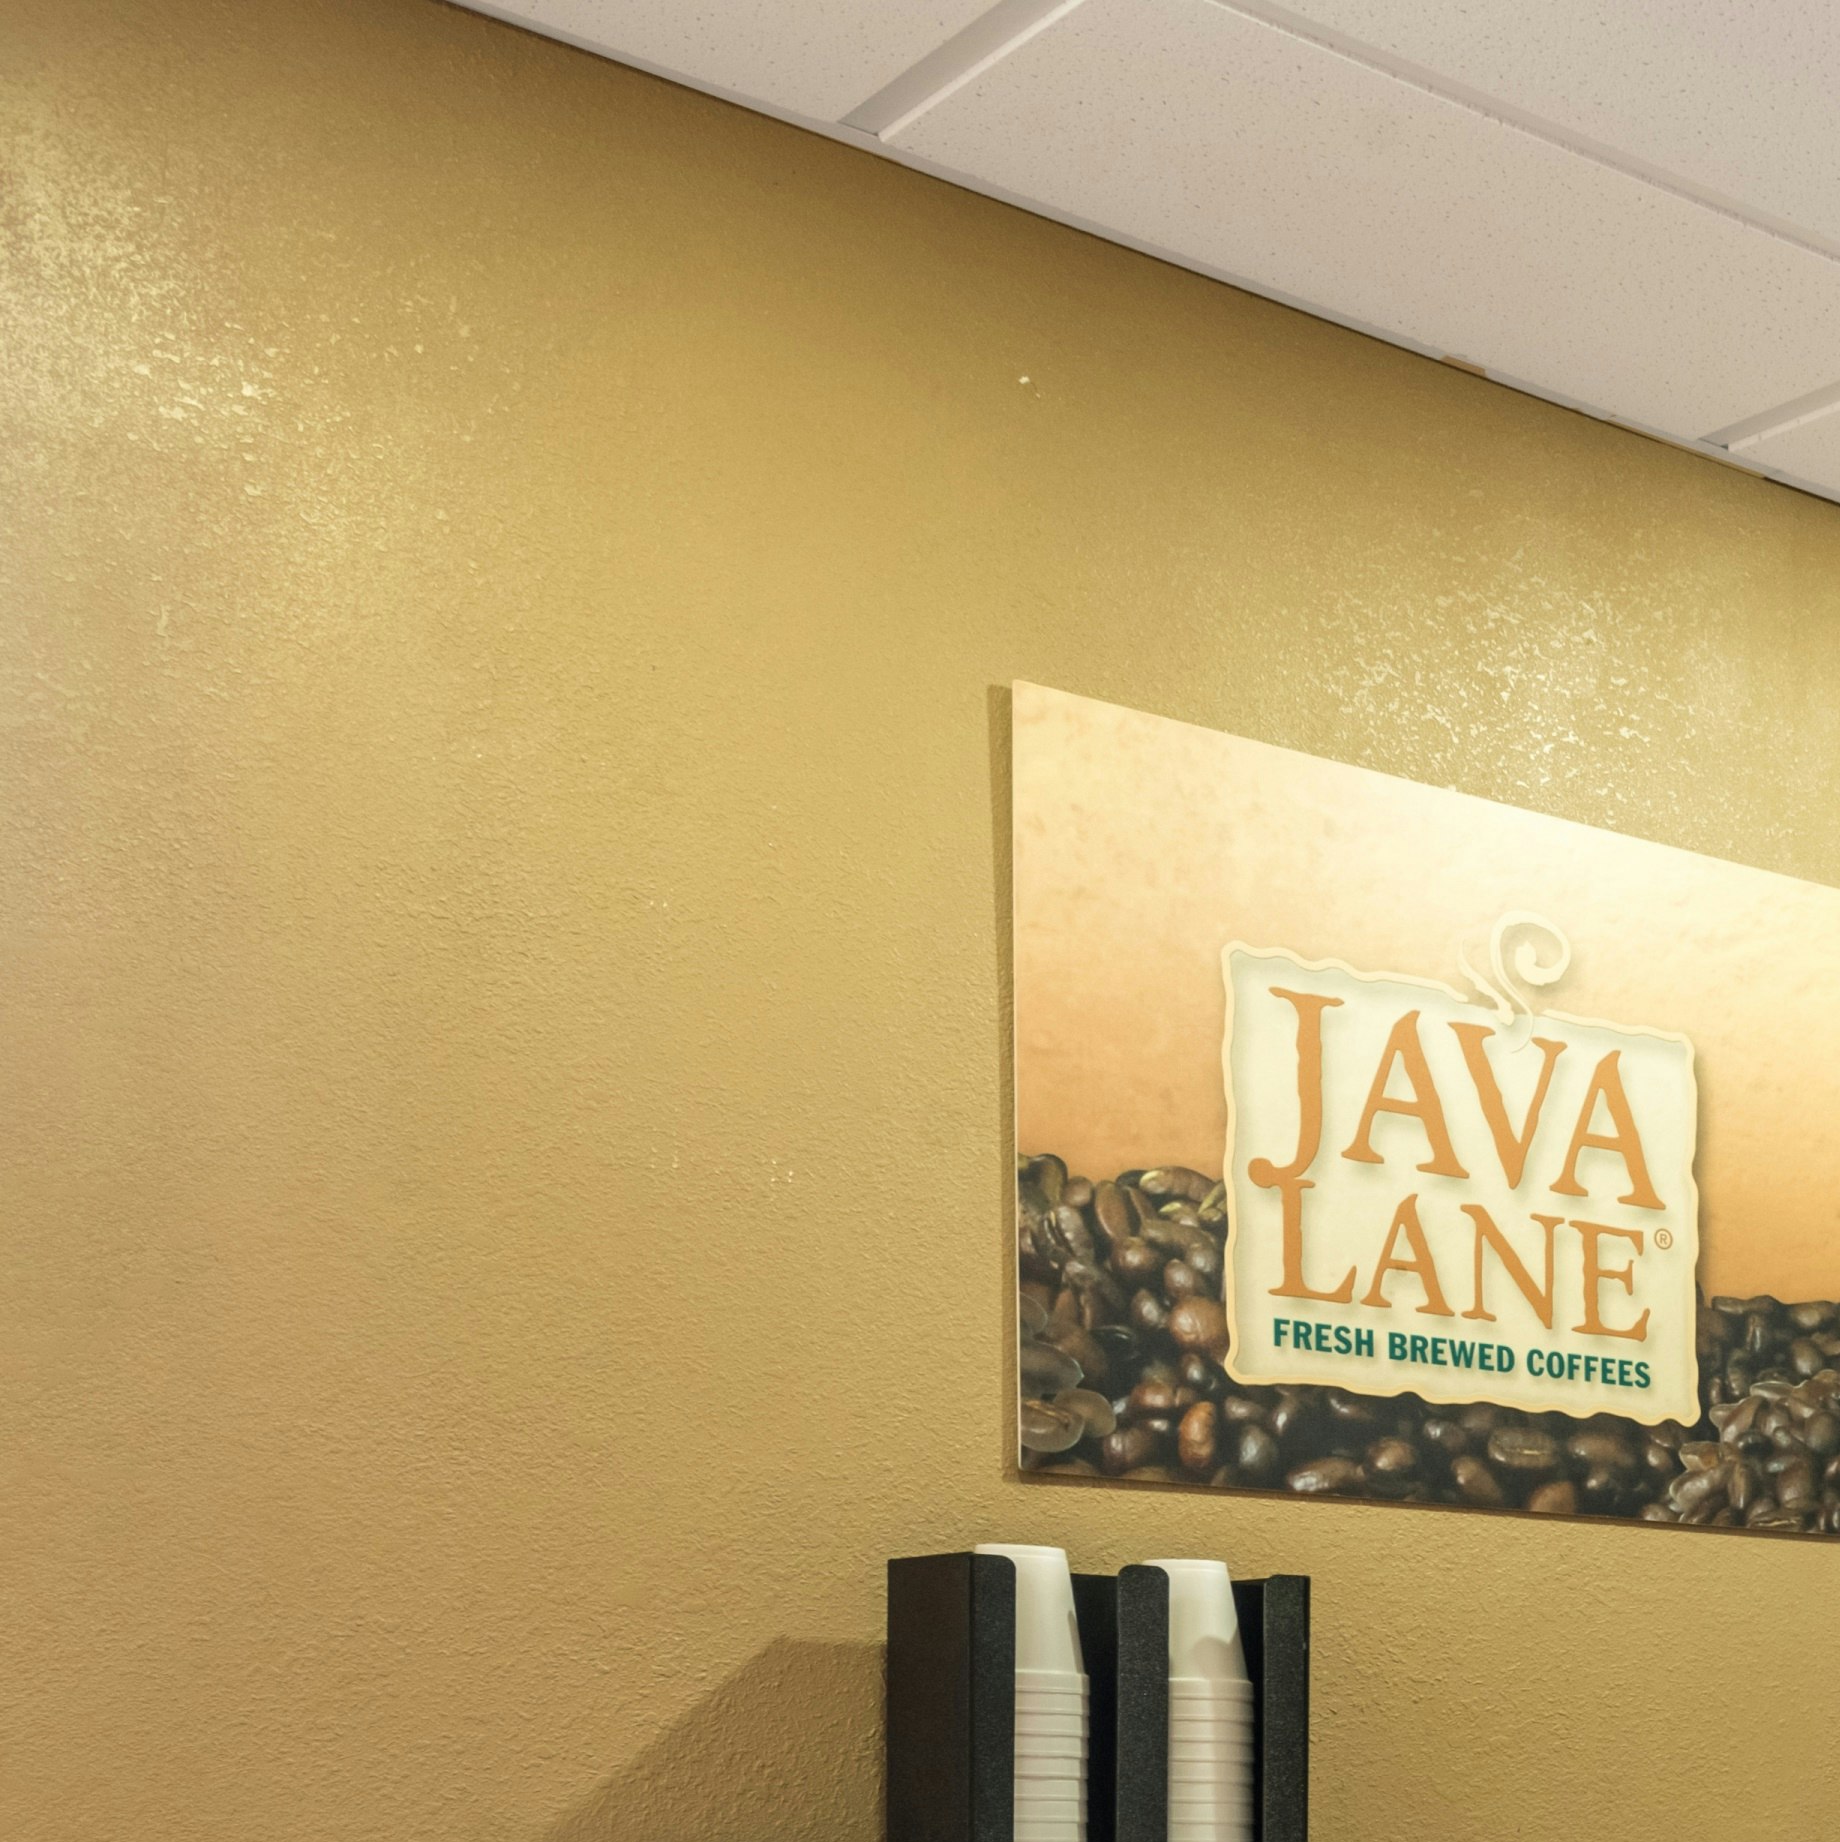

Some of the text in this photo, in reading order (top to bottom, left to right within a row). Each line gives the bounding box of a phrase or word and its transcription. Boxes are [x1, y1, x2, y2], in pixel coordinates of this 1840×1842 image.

[1248, 986, 1667, 1211] JAVA
[1267, 1178, 1652, 1343] LANE
[1272, 1317, 1652, 1389] FRESH BREWED COFFEES
